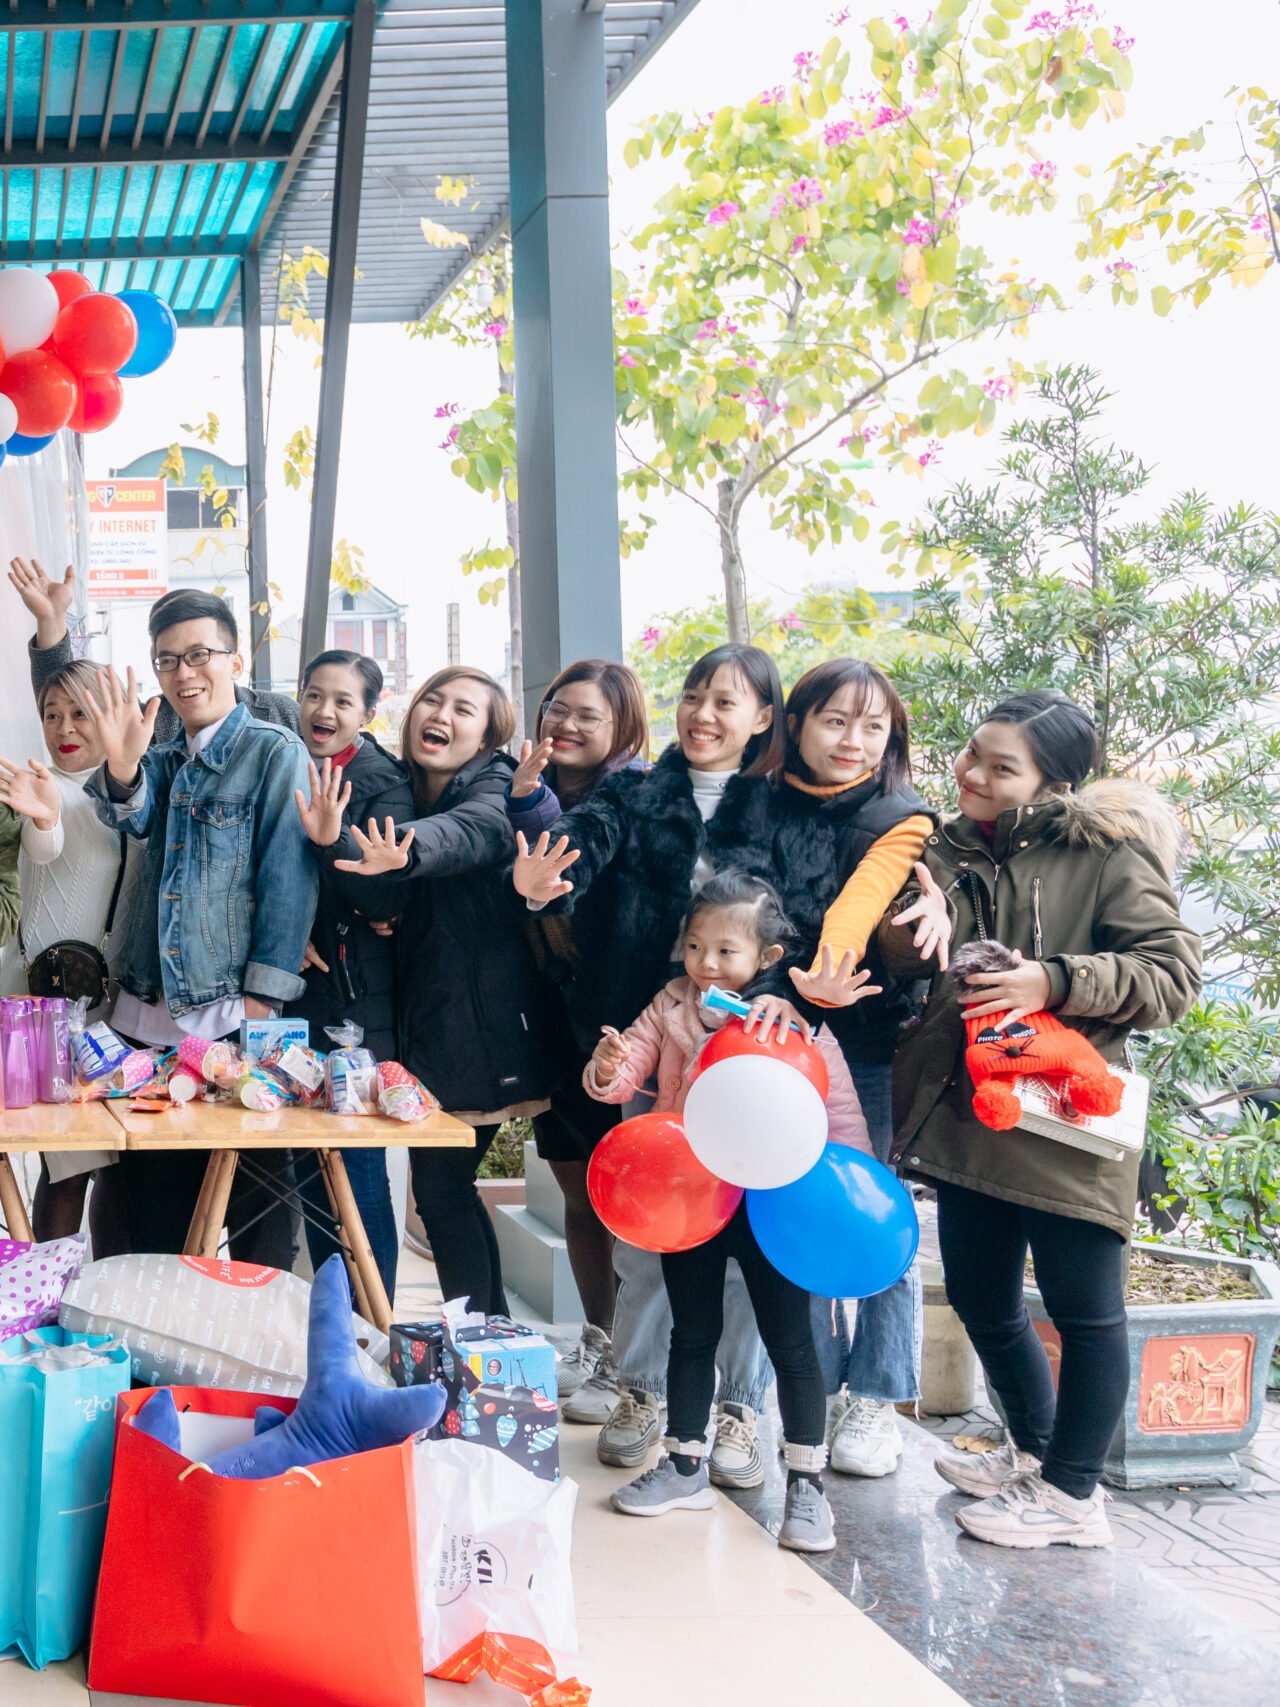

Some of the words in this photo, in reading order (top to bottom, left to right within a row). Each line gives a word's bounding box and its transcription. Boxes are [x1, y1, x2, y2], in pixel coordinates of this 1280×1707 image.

[116, 490, 156, 502] CENTER
[99, 519, 157, 533] INTERNET
[977, 1035, 1004, 1043] PHOTO
[1011, 1028, 1037, 1039] PHOTO
